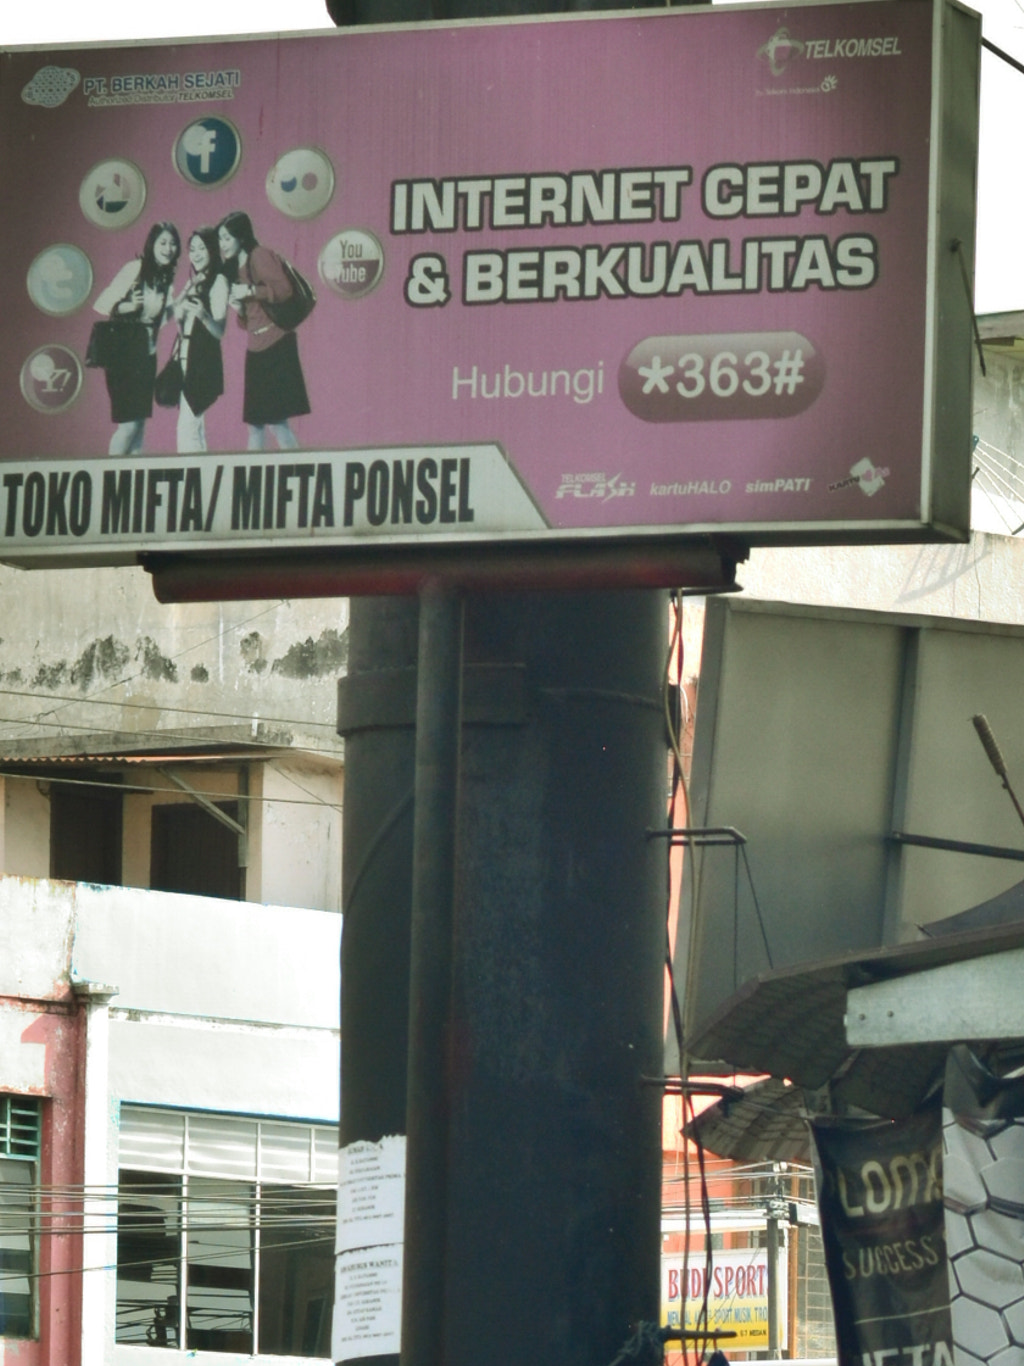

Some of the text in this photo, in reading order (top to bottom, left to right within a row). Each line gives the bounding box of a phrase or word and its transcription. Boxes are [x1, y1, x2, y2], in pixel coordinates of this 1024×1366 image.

[804, 37, 902, 59] TELKOMSEL
[84, 71, 240, 94] PT. BERKAH SEJATI
[392, 159, 897, 234] INTERNET CEPAT
[340, 240, 363, 258] You
[406, 237, 877, 305] & BERKUALITAS
[451, 361, 604, 404] Hubungi
[3, 458, 474, 538] TOKO MIFTA/ MIFTA PONSEL
[650, 480, 732, 497] kartuHALO
[745, 478, 811, 493] simPATI
[842, 1235, 939, 1280] SUCCESS
[713, 1265, 768, 1299] SPORT
